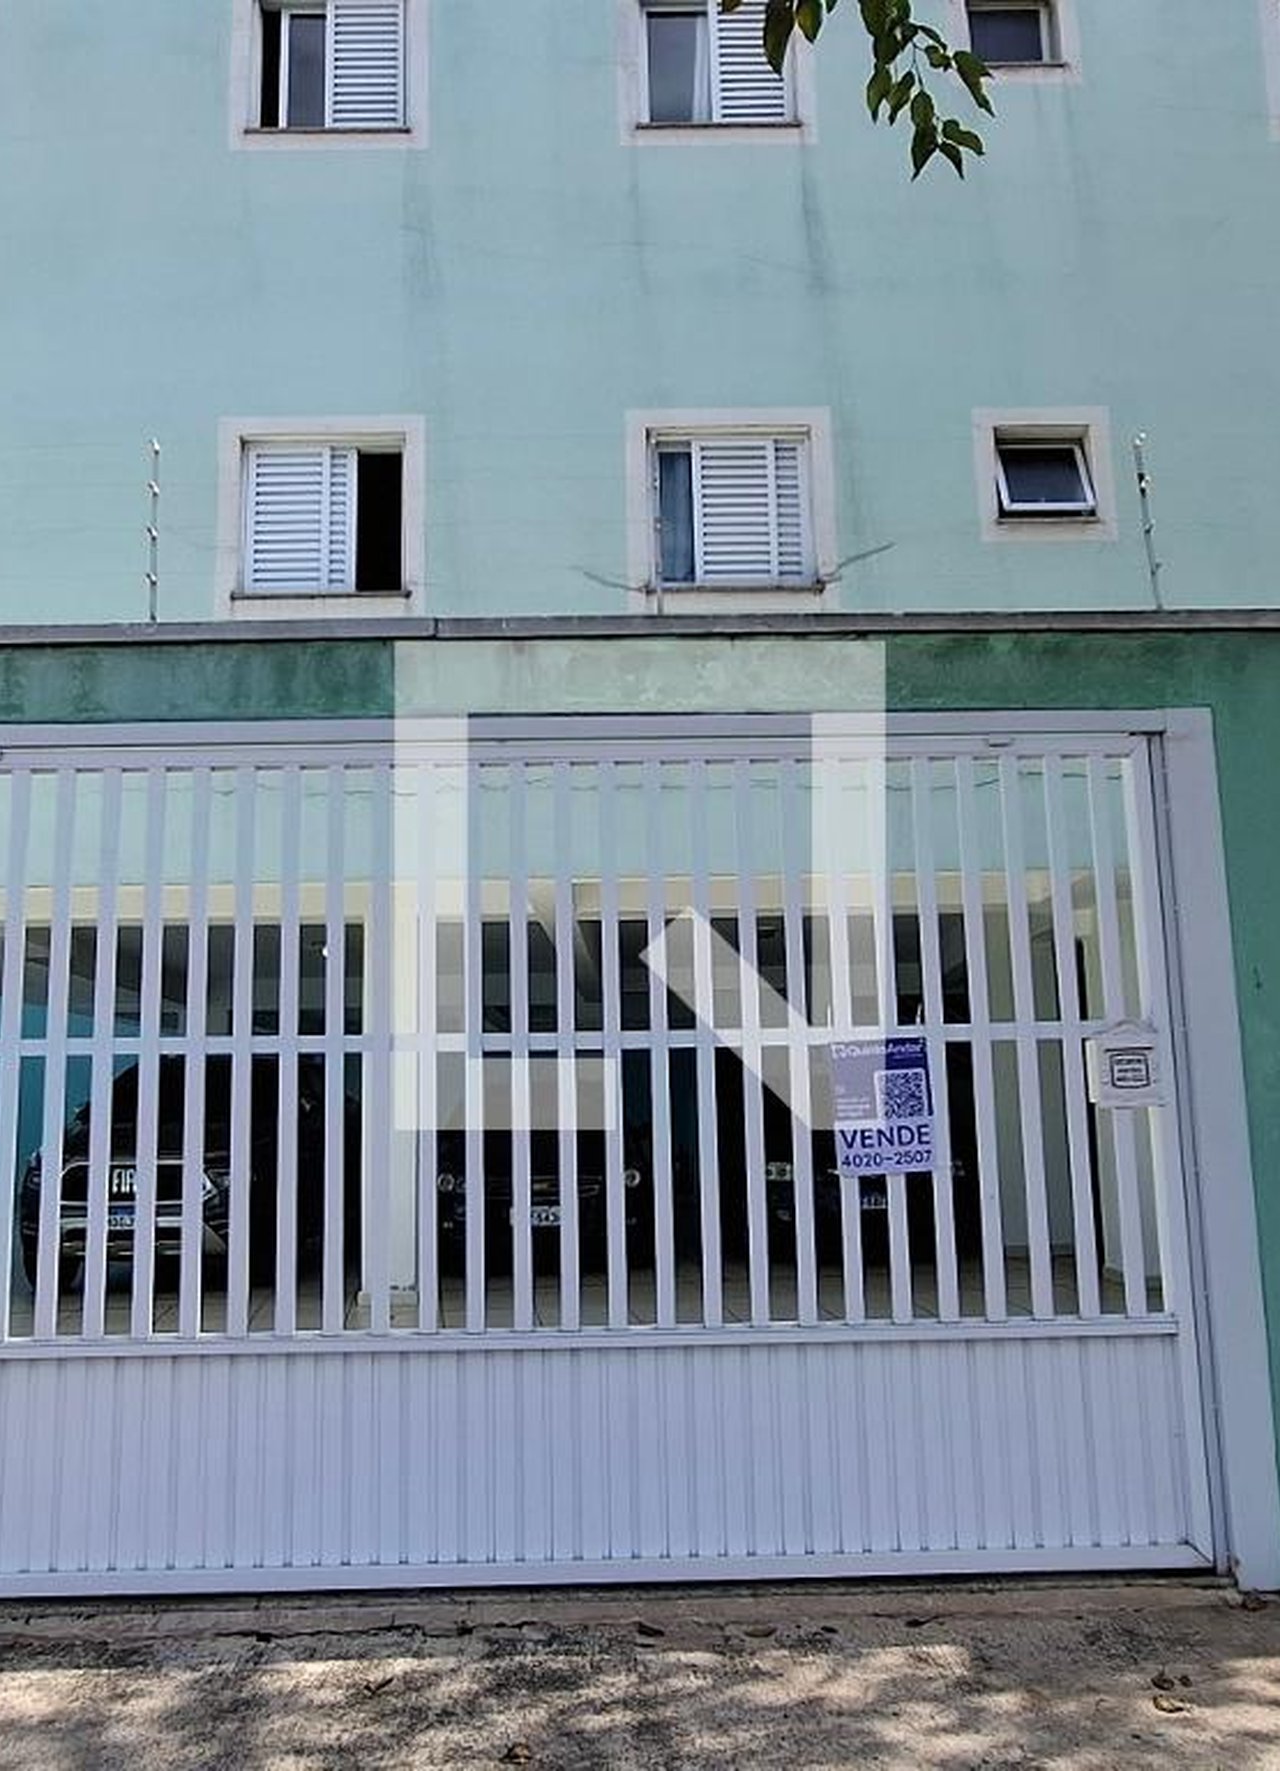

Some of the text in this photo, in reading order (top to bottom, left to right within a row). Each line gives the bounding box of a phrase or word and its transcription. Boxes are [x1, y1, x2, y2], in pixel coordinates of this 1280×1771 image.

[840, 1124, 931, 1149] VENDE
[841, 1150, 932, 1168] 4020-2507
[112, 1169, 137, 1193] FIA
